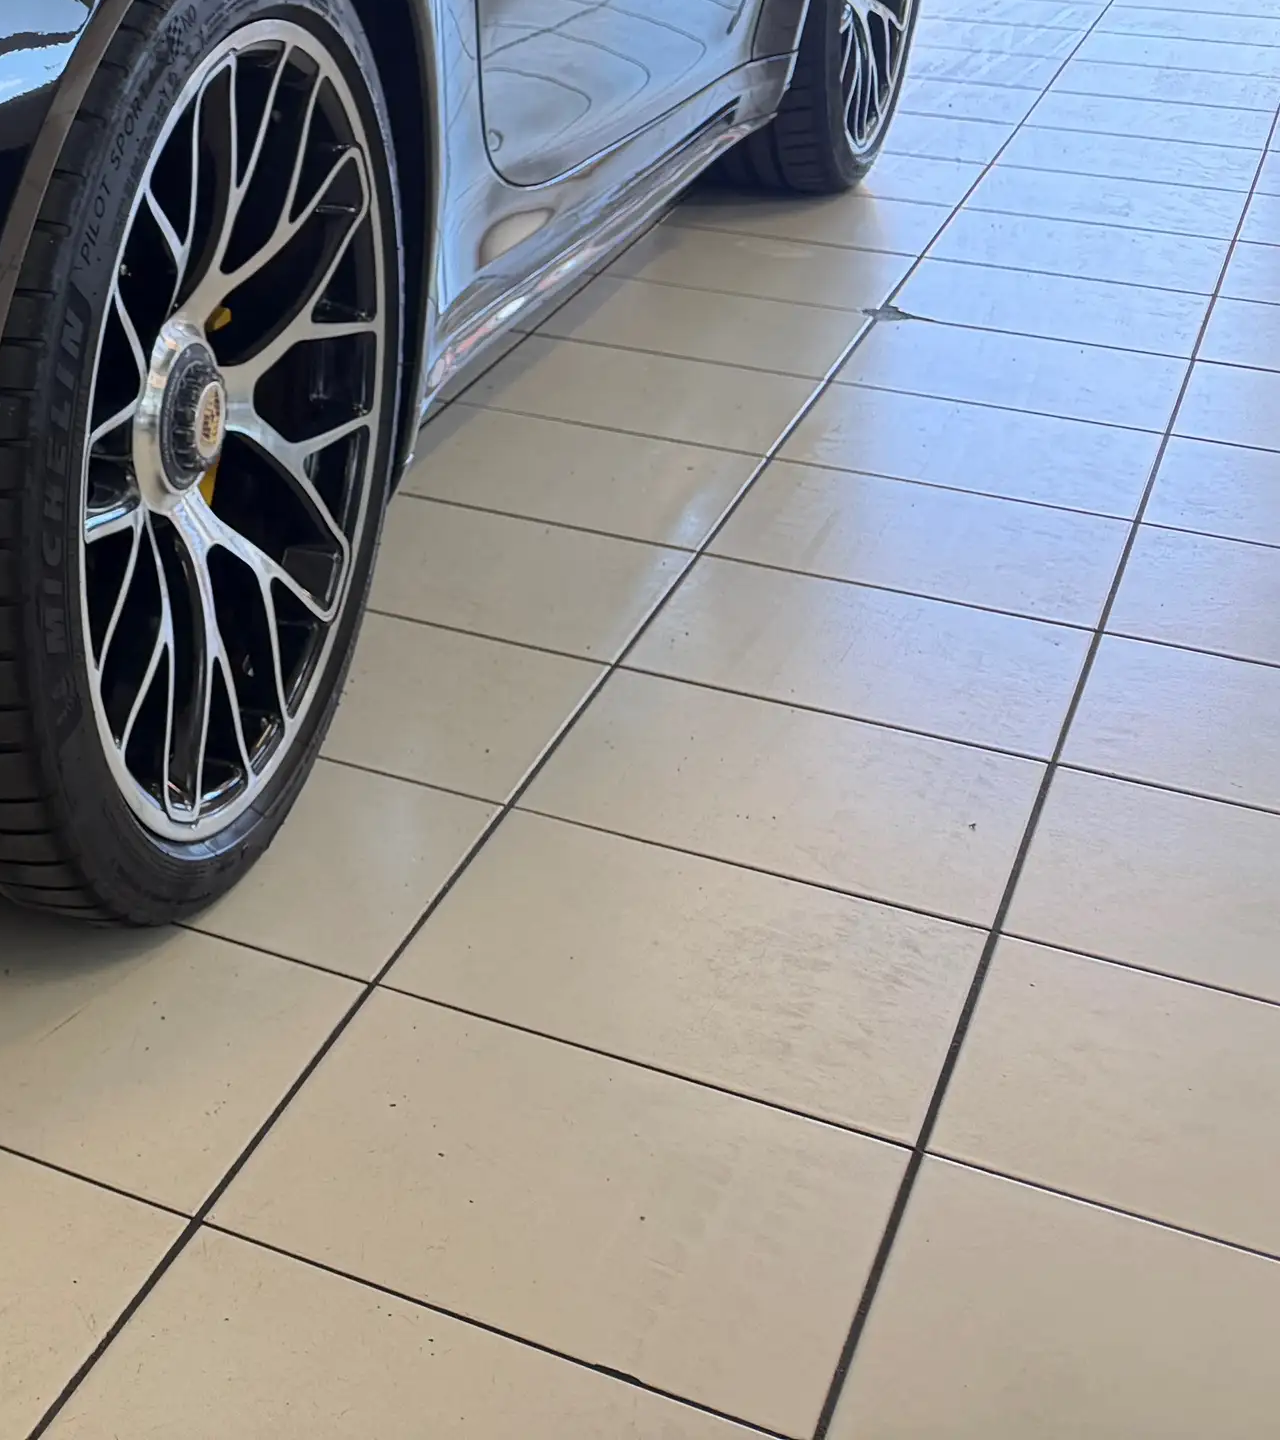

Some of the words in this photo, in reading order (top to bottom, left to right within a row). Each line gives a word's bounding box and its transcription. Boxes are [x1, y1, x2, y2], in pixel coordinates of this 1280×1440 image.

[80, 174, 112, 267] PILOT
[110, 85, 151, 171] SPORT
[42, 308, 85, 654] MICHELIN
